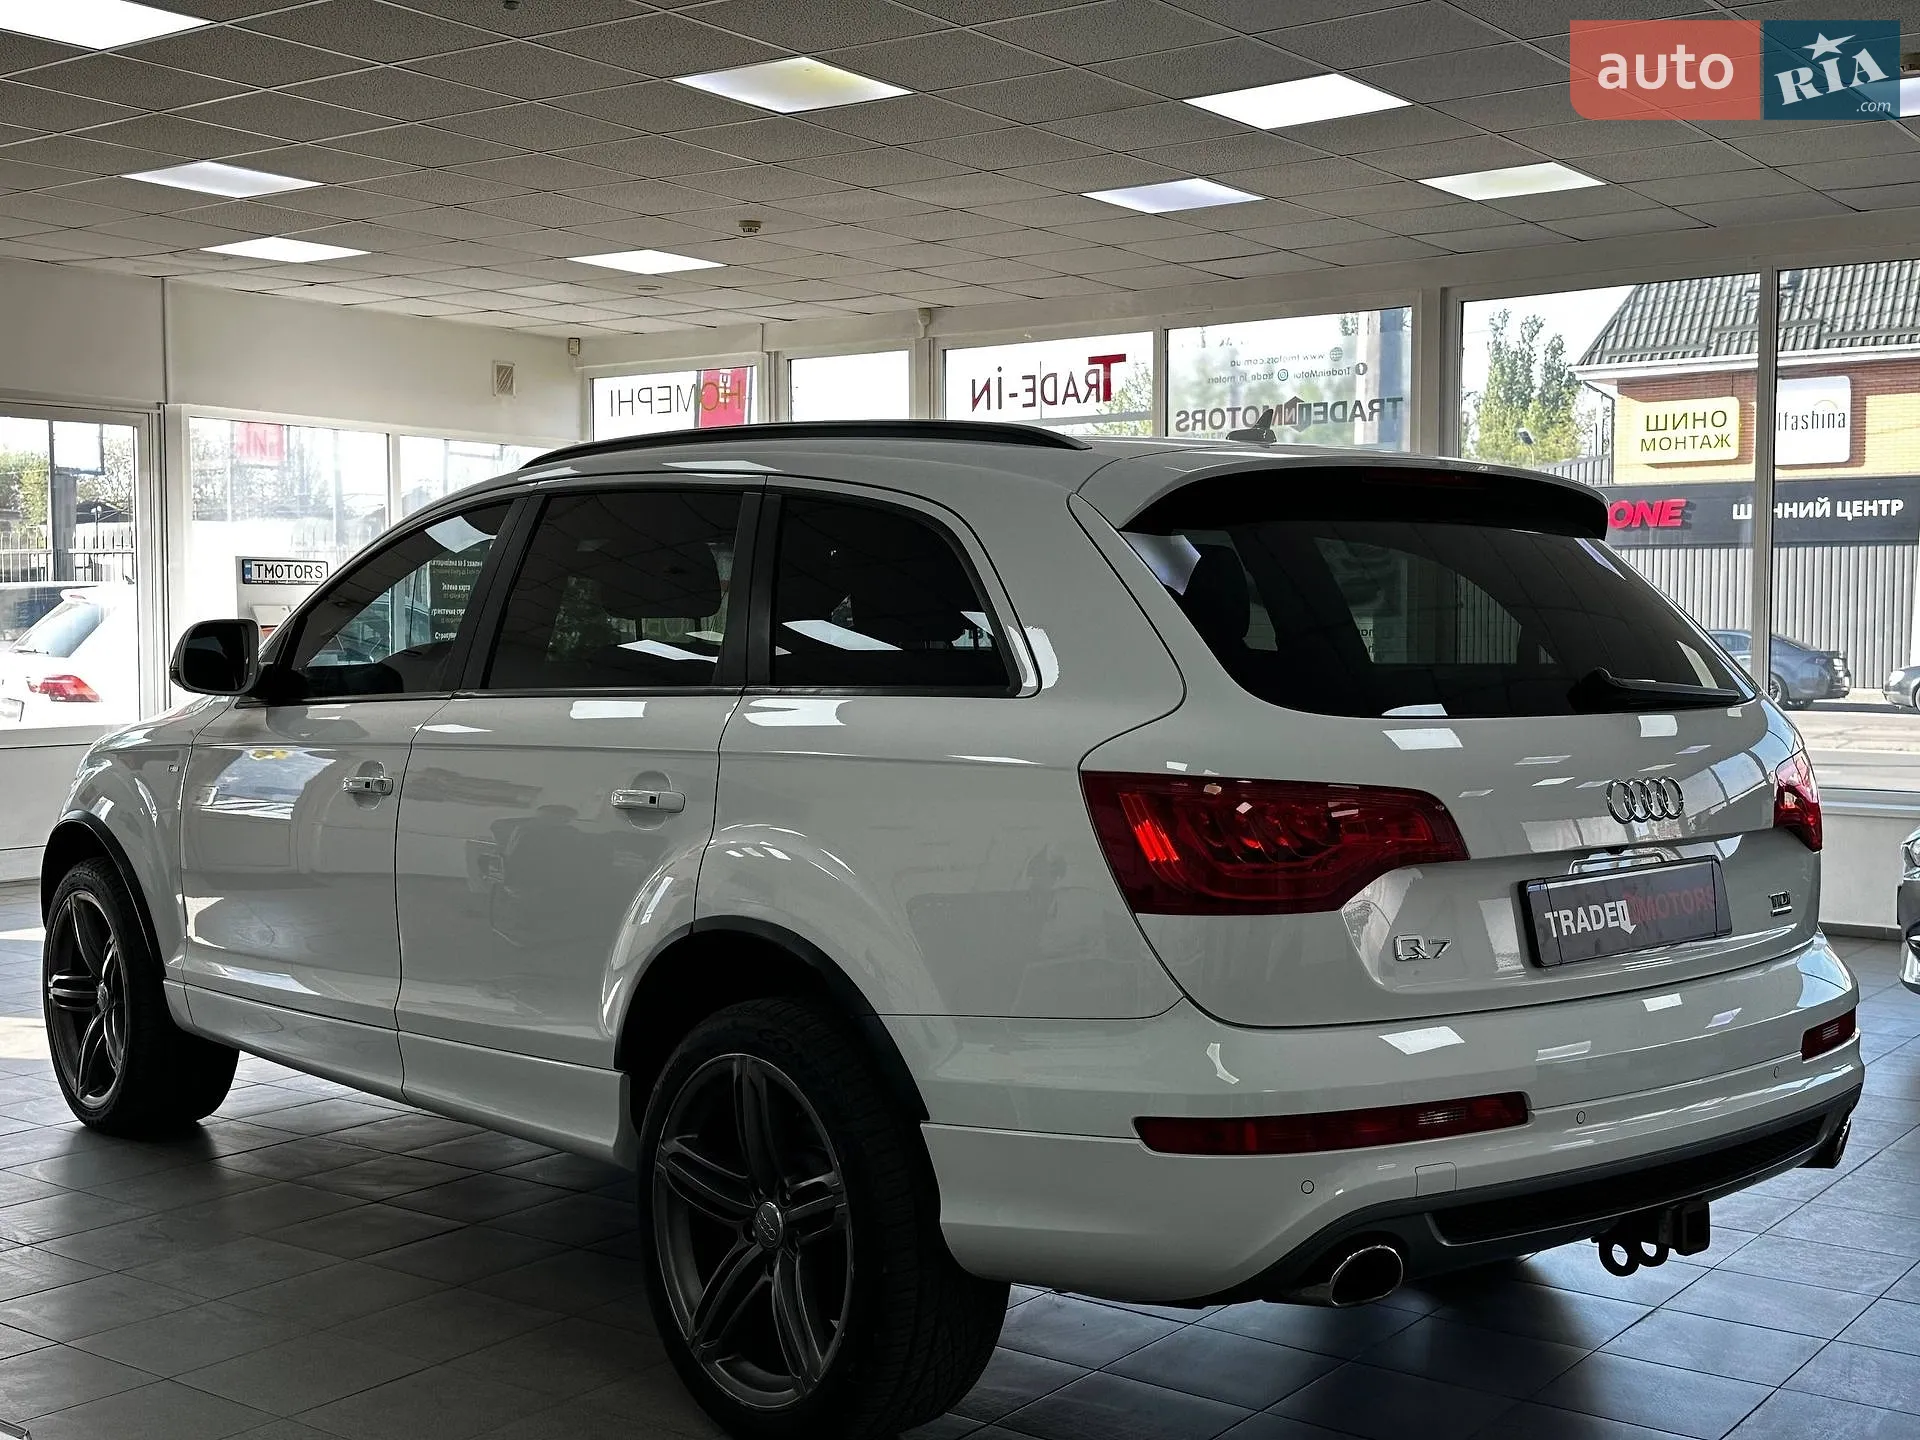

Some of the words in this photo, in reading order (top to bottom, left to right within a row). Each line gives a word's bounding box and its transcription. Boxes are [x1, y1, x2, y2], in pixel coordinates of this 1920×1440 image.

[1645, 410, 1728, 432] ШИНО
[1778, 410, 1846, 431] lfashina
[1640, 434, 1732, 452] МОНТАЖ
[1732, 497, 1831, 520] ШННИЙ
[1836, 499, 1904, 521] ЦЕНТР
[254, 564, 324, 579] TMOTORS
[1394, 934, 1452, 961] Q7
